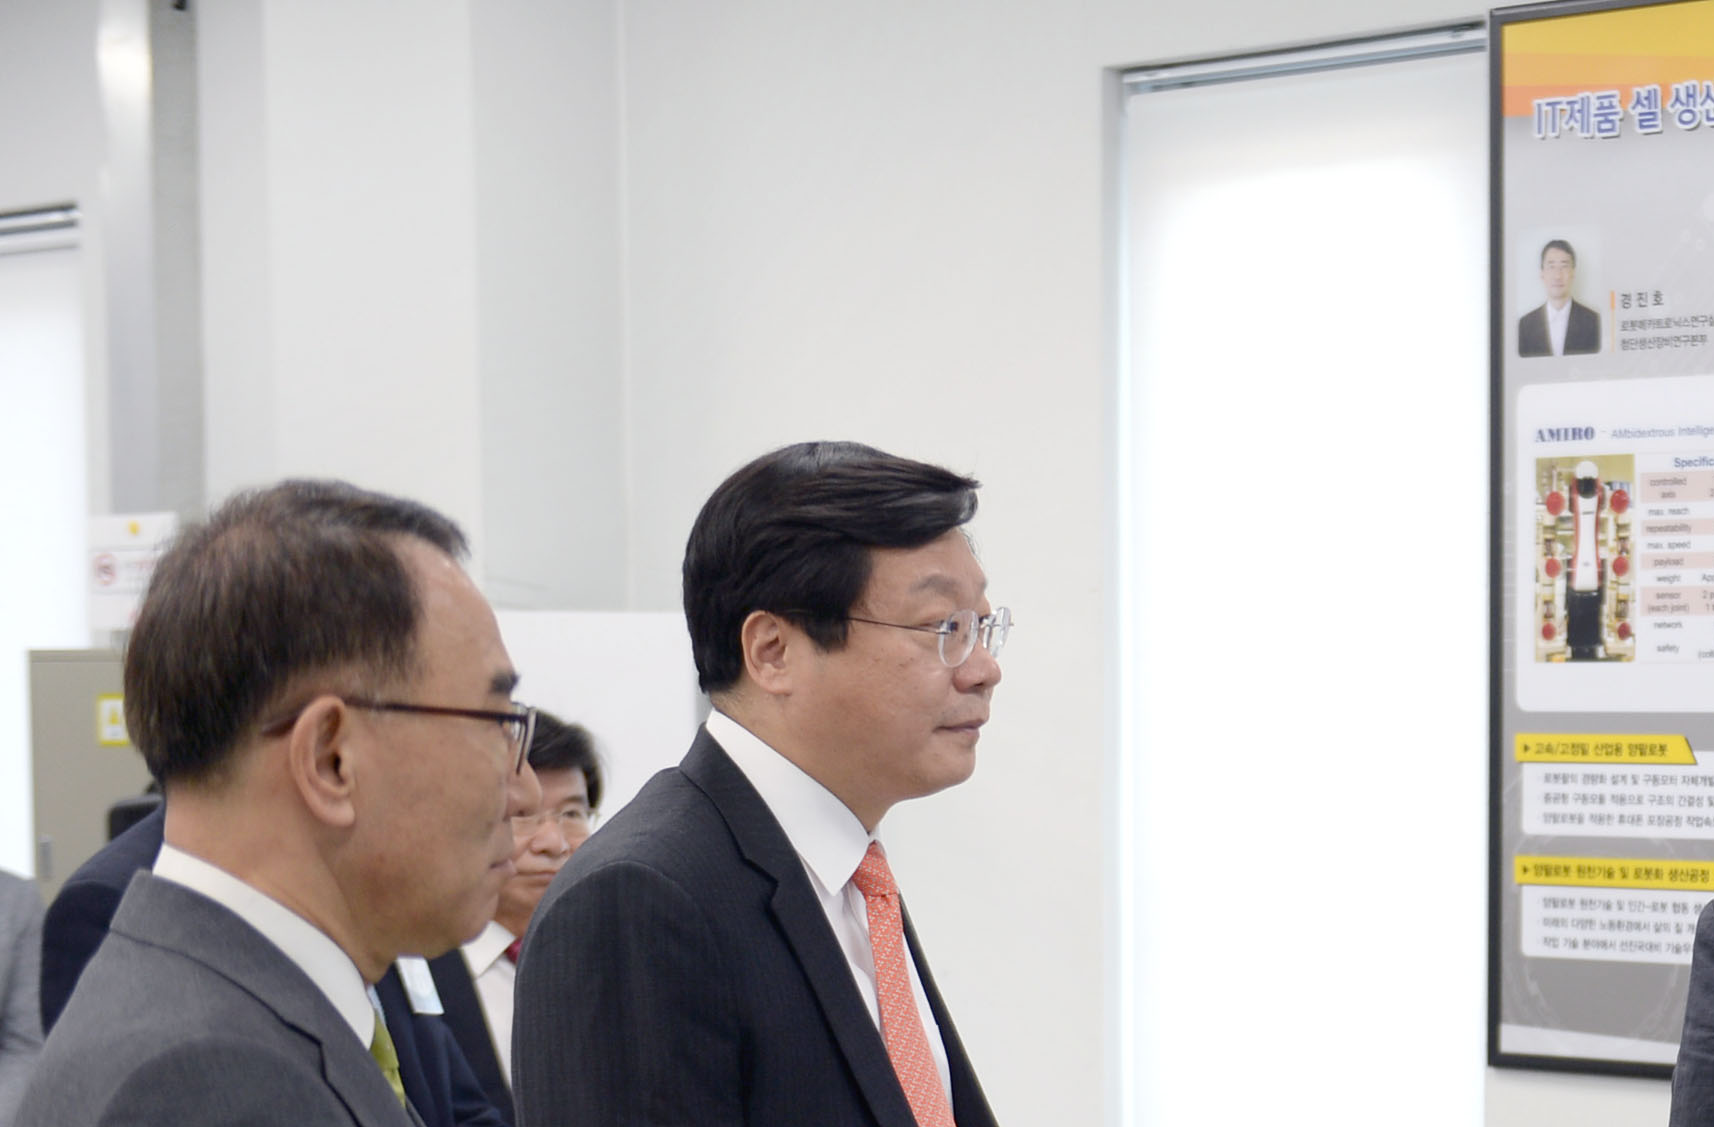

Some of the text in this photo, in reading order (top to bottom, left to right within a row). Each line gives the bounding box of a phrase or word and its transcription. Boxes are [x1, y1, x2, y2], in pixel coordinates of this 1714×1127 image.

[1535, 92, 1621, 135] IT제품
[1631, 86, 1661, 130] 셀
[1535, 426, 1595, 443] AMIRO
[1535, 742, 1668, 758] 고속/고정밀 산업용 양팔로봇
[1534, 863, 1571, 878] 양팔로봇
[1577, 864, 1616, 880] 원천기술
[1669, 867, 1710, 884] 생산공정
